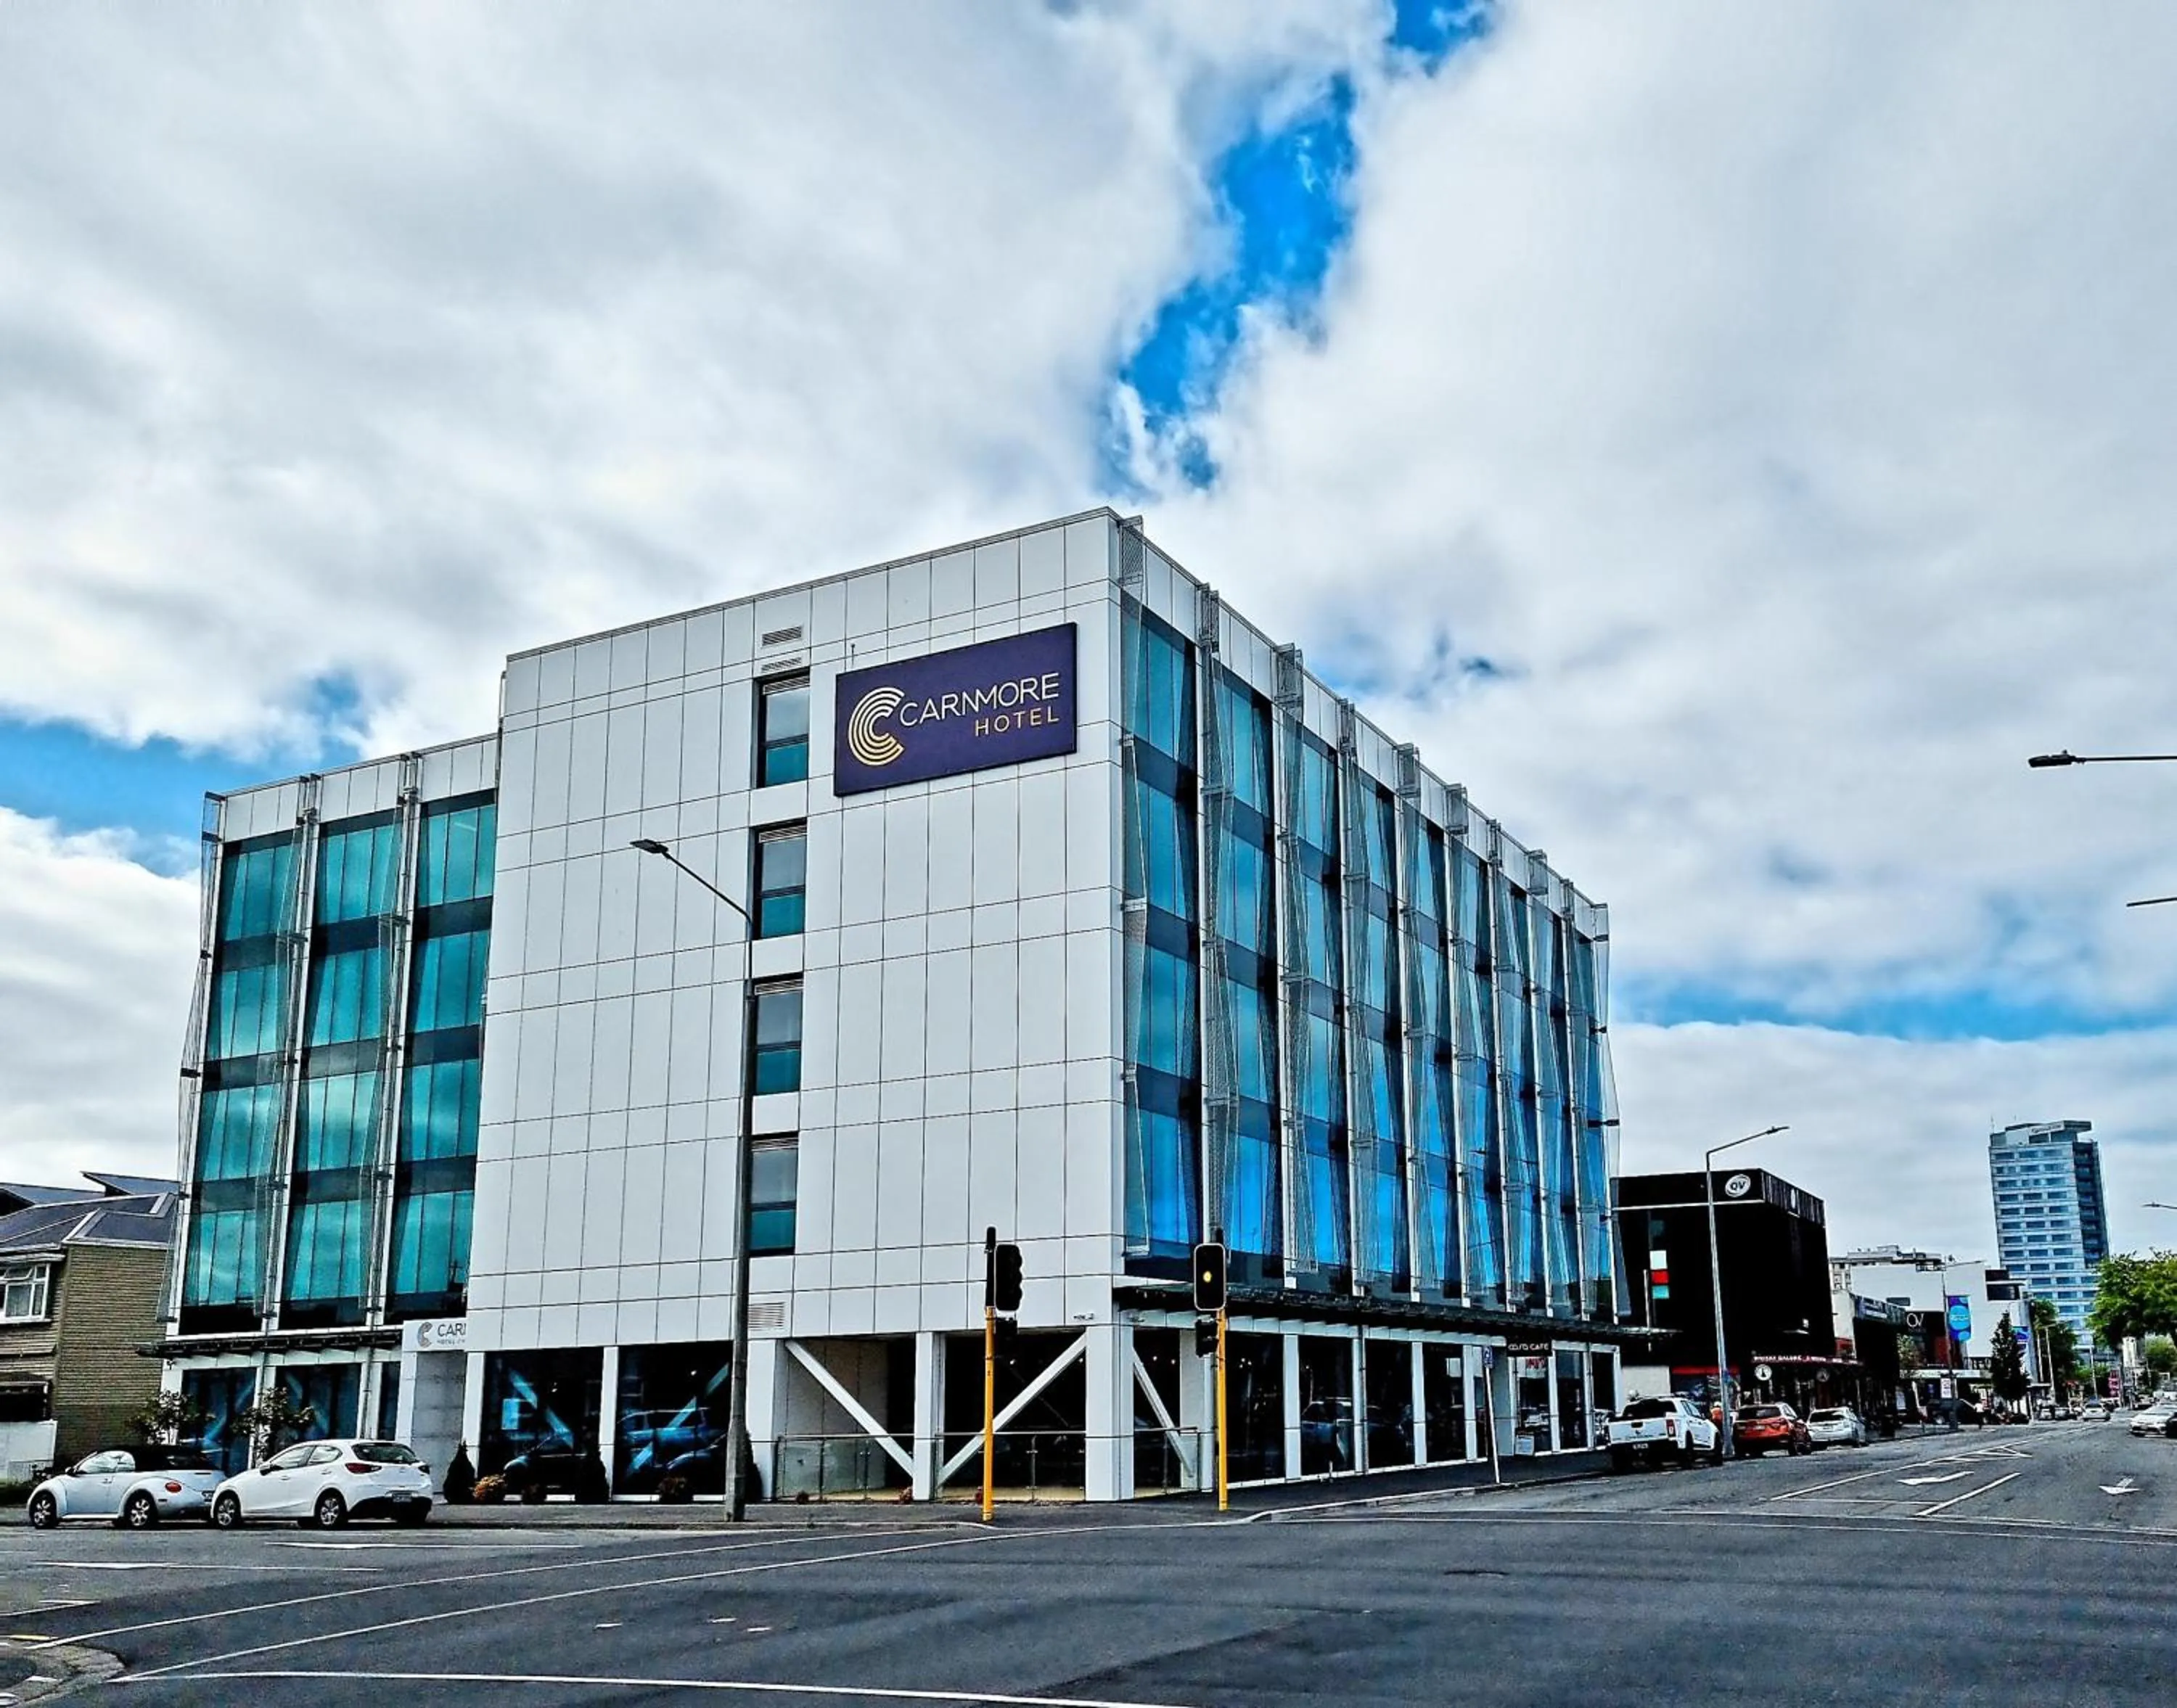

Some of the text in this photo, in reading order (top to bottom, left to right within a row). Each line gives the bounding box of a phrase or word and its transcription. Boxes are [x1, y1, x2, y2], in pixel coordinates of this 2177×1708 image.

[900, 672, 1059, 726] CARNMORE
[975, 706, 1060, 737] HOTEL
[1730, 1181, 1746, 1191] QV
